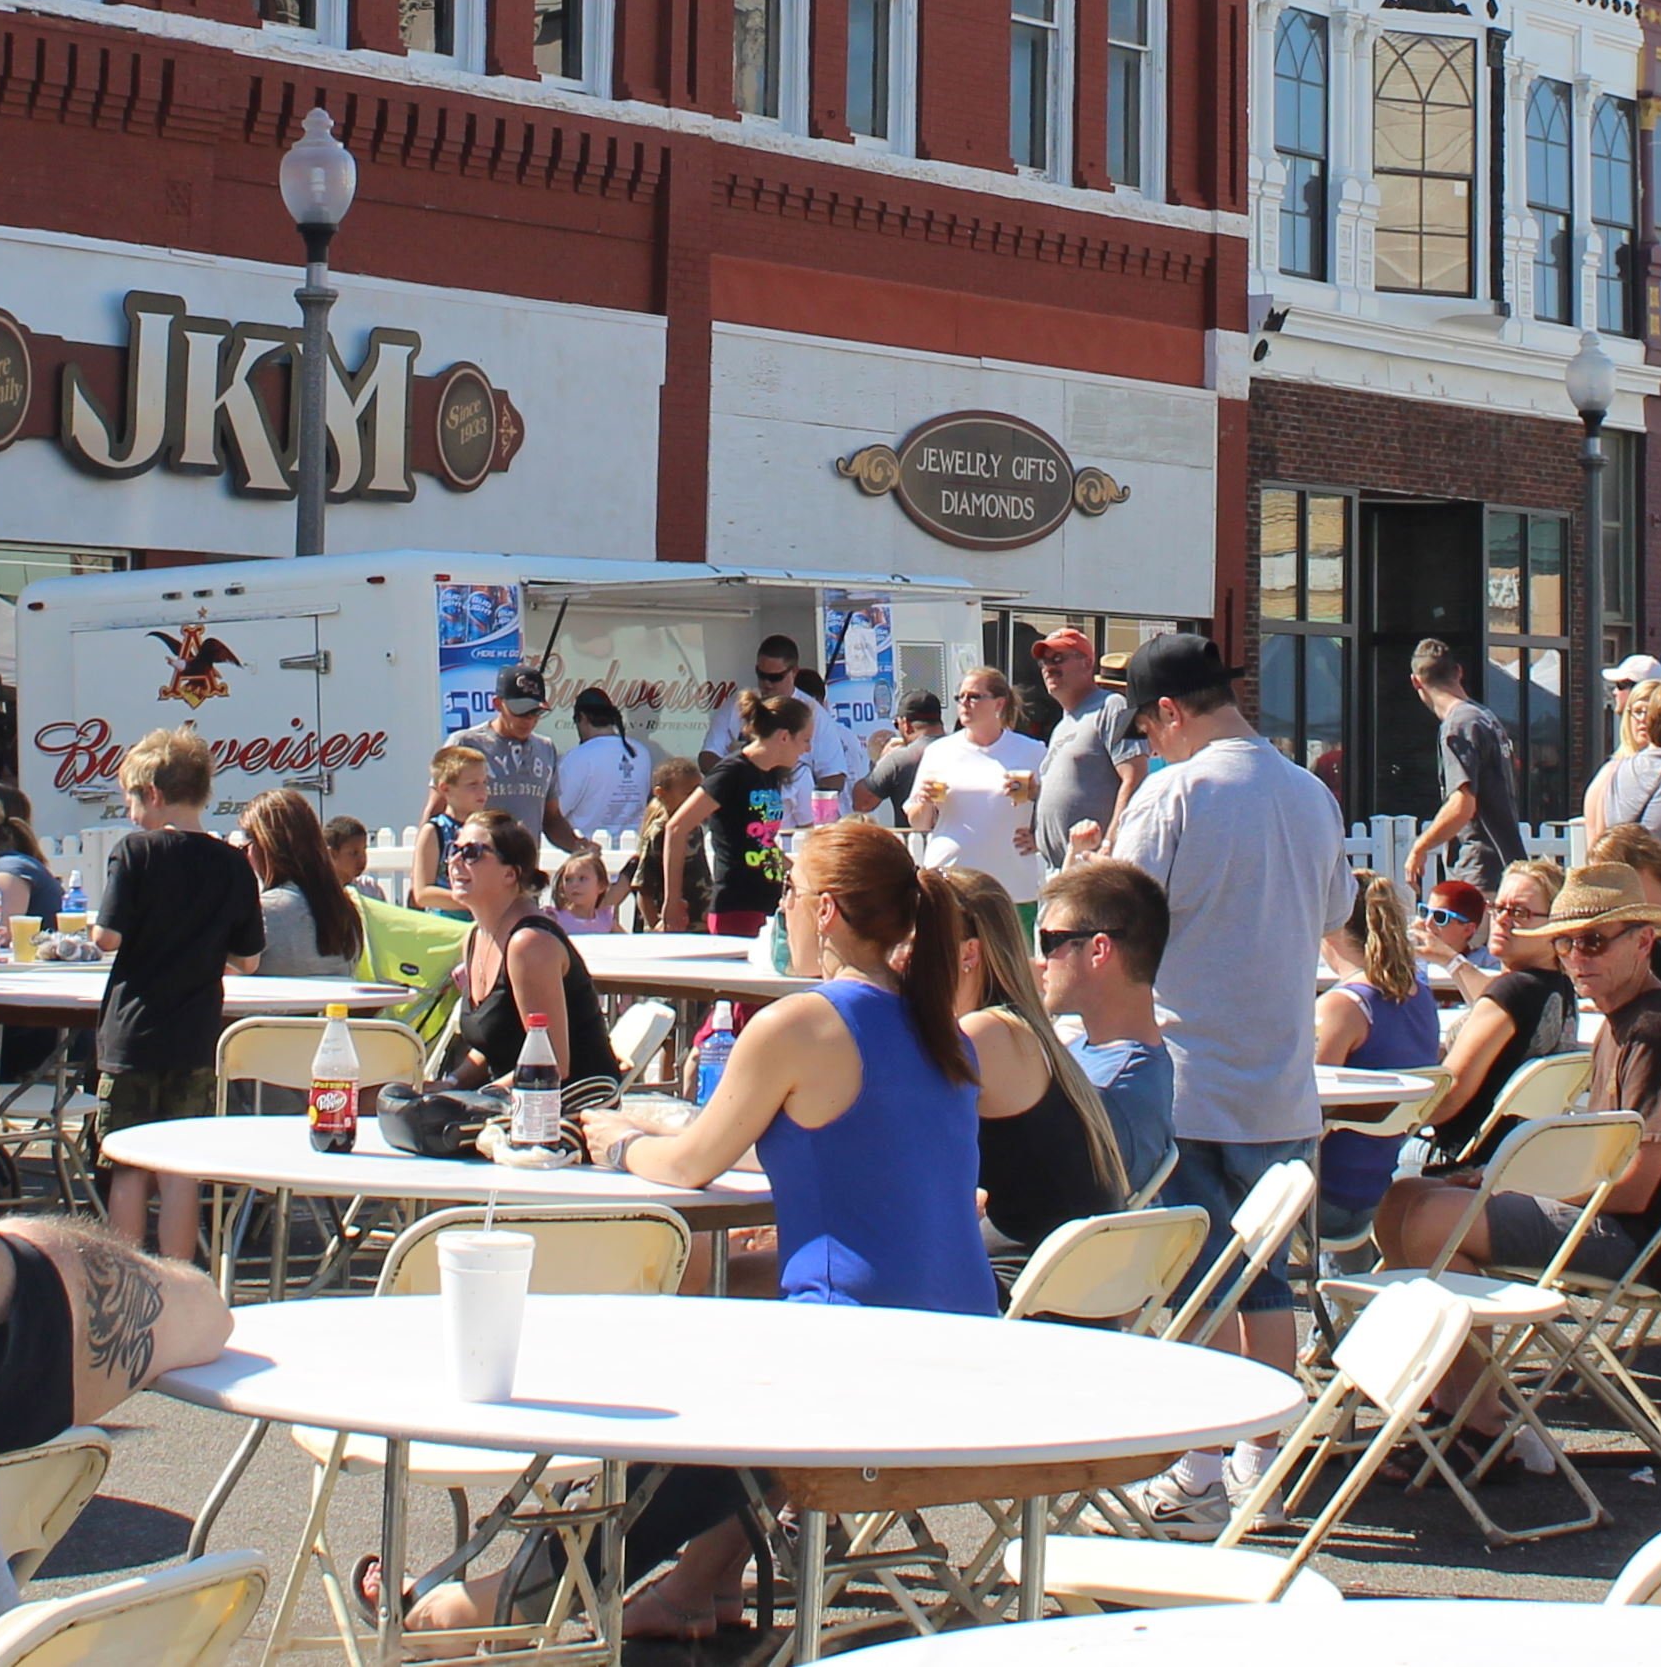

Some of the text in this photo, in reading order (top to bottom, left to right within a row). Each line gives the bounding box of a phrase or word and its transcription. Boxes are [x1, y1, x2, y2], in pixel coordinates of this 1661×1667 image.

[66, 301, 419, 500] JKM
[445, 399, 482, 430] Since
[460, 416, 488, 445] 1933
[916, 445, 1057, 483] JEWELRY GIFTS
[941, 489, 1035, 521] DIAMONDS
[33, 716, 389, 792] Buweiser
